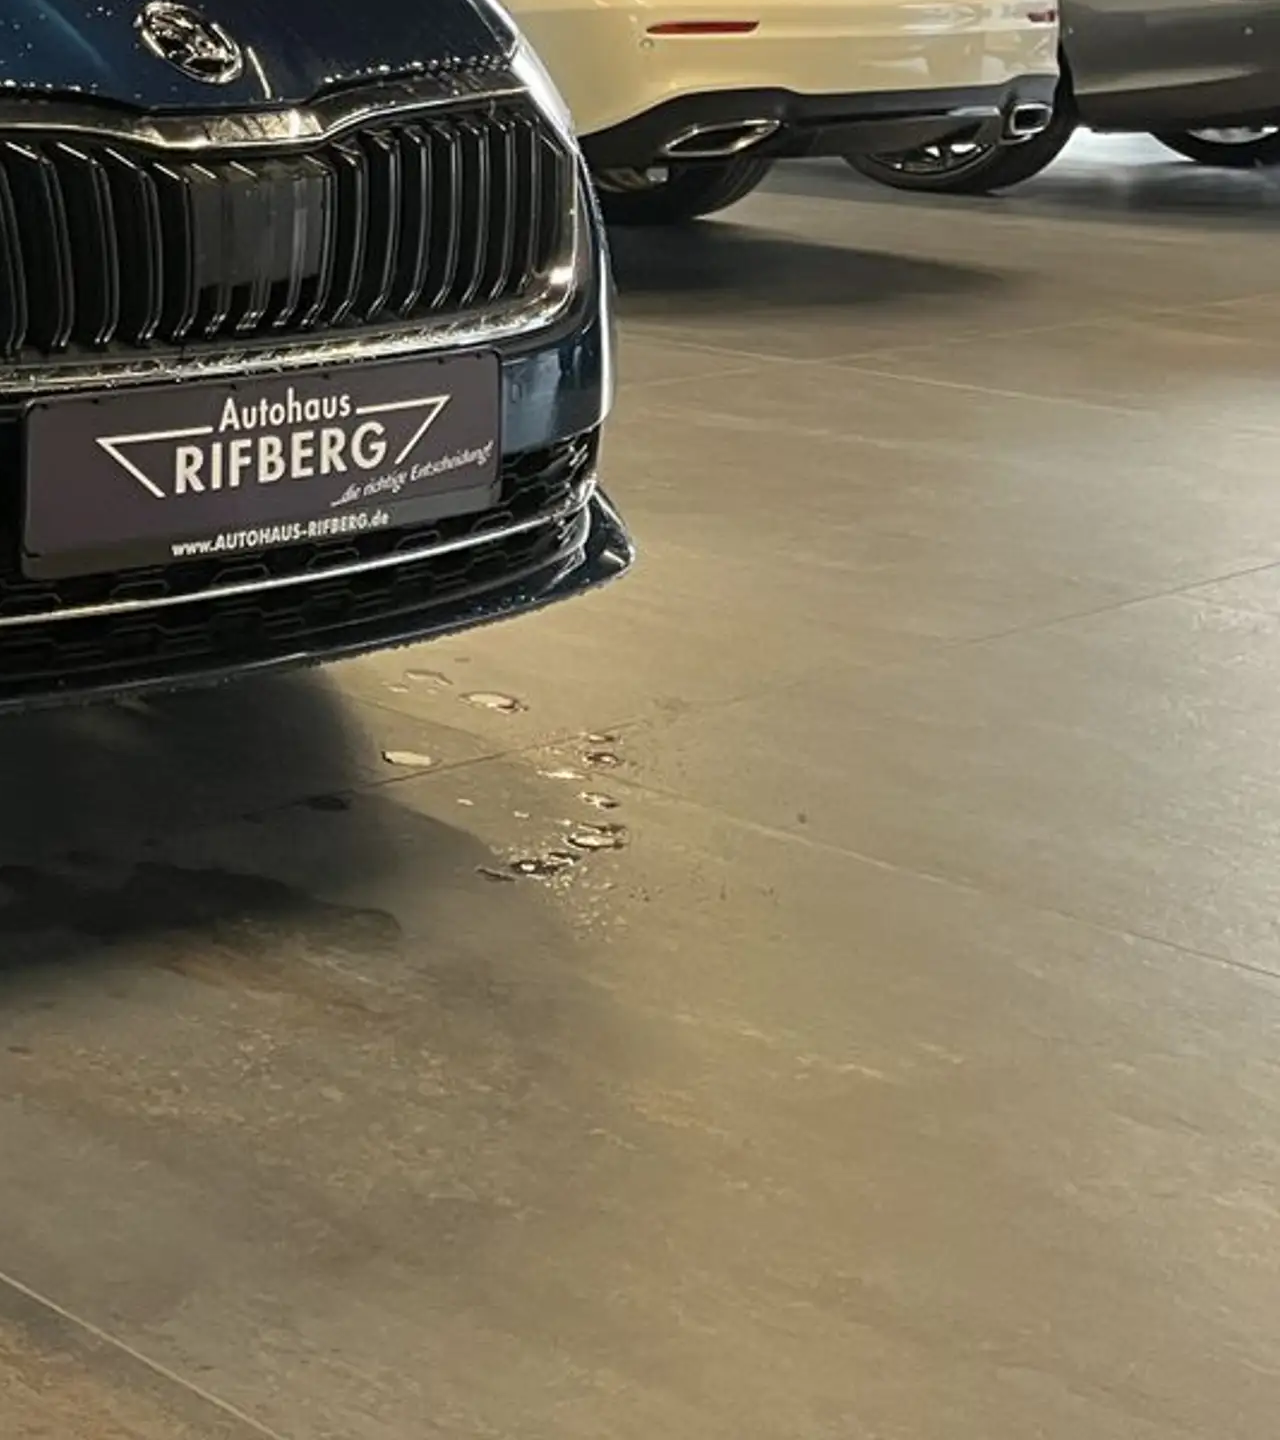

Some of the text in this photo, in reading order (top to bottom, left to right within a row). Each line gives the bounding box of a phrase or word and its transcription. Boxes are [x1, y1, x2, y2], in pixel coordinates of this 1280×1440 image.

[218, 386, 352, 434] Autohaus
[174, 420, 388, 495] RIFBERG
[171, 509, 390, 557] www.AUTOHAUS-RIFBERG.de
